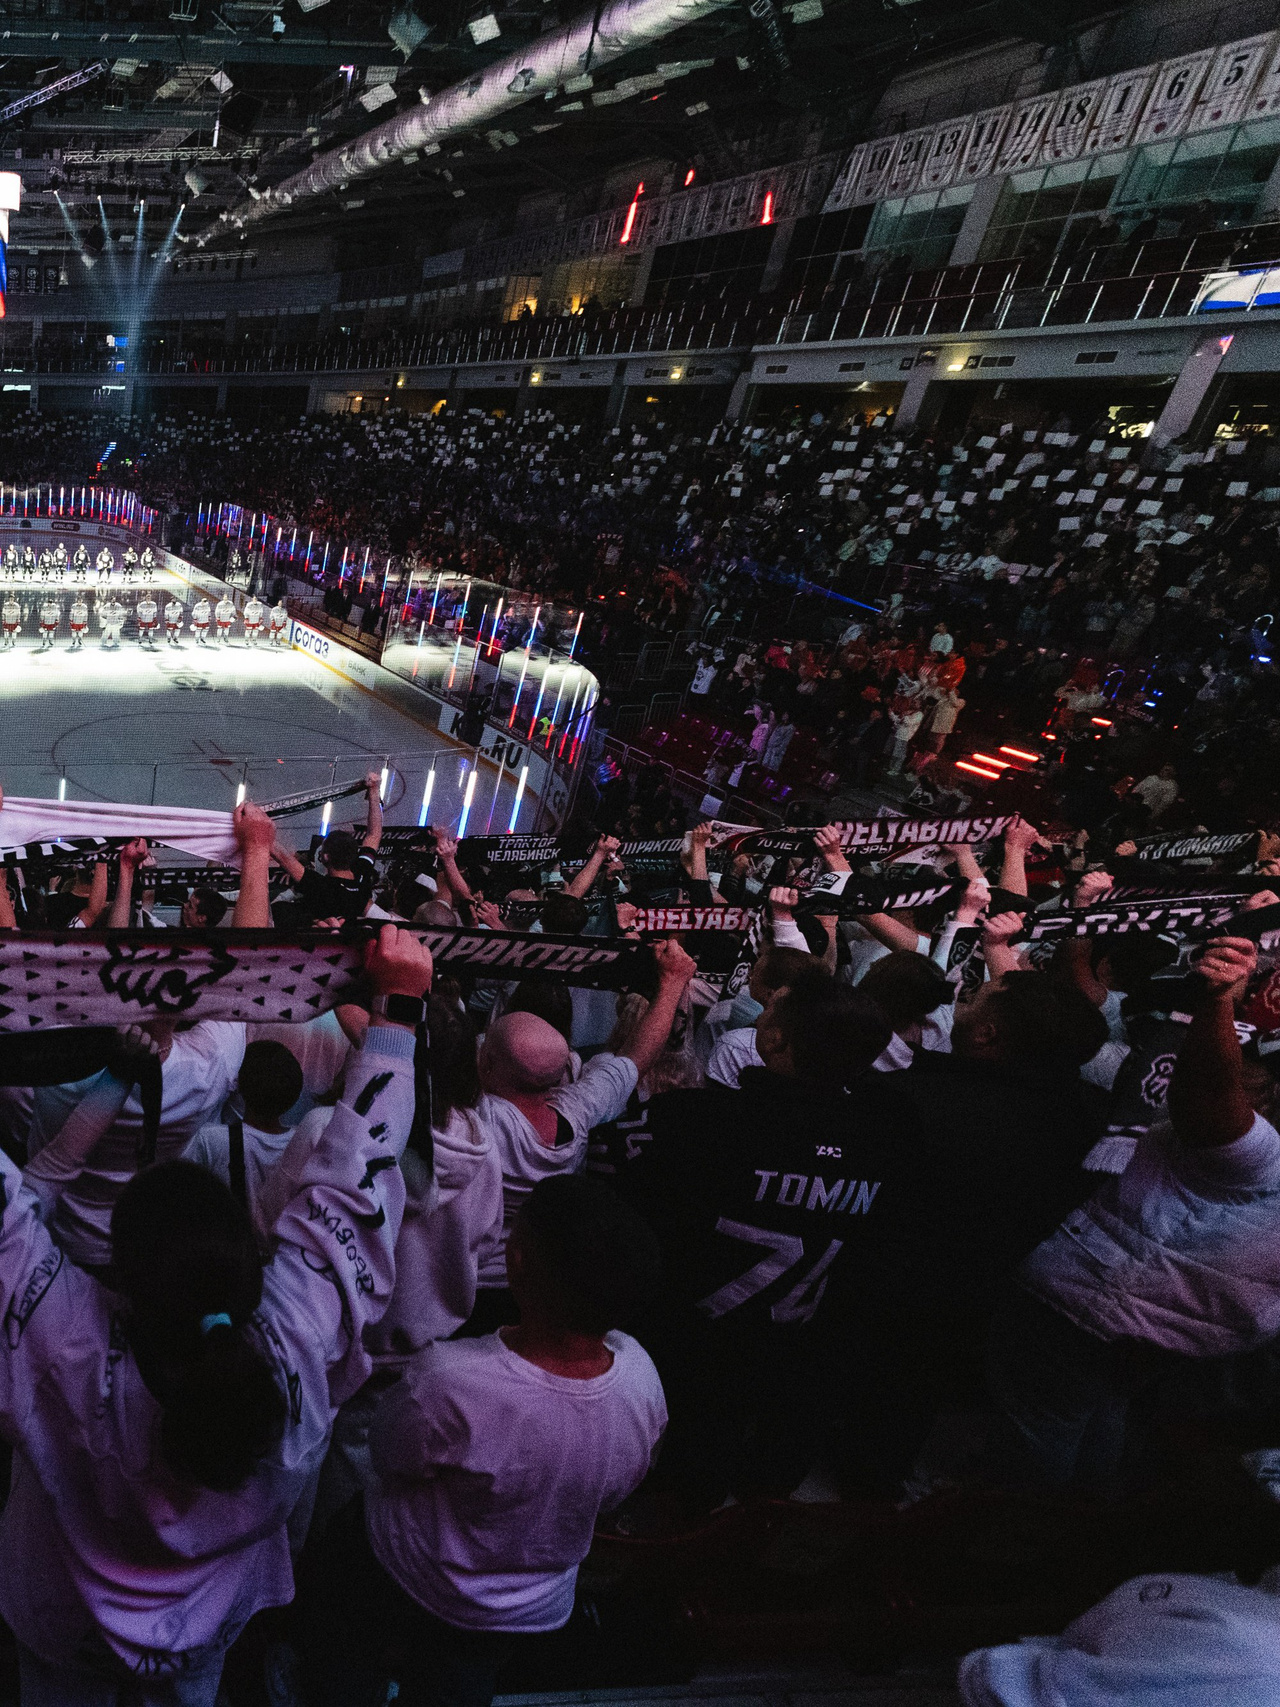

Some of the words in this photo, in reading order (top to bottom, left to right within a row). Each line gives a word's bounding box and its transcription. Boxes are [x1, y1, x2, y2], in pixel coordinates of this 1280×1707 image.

[1166, 69, 1190, 100] 6
[1224, 53, 1250, 86] 5
[1056, 96, 1091, 128] 18
[898, 139, 924, 165] 21
[933, 130, 961, 157] 13
[450, 712, 523, 769] K.RU
[499, 836, 558, 850] ТРАКТОР
[833, 816, 1013, 846] HELYABINSK
[486, 848, 561, 862] ЧЕЛЯБИНСК
[631, 906, 755, 932] CHELYABI
[754, 1168, 882, 1215] TOMIN
[694, 1216, 844, 1324] 74
